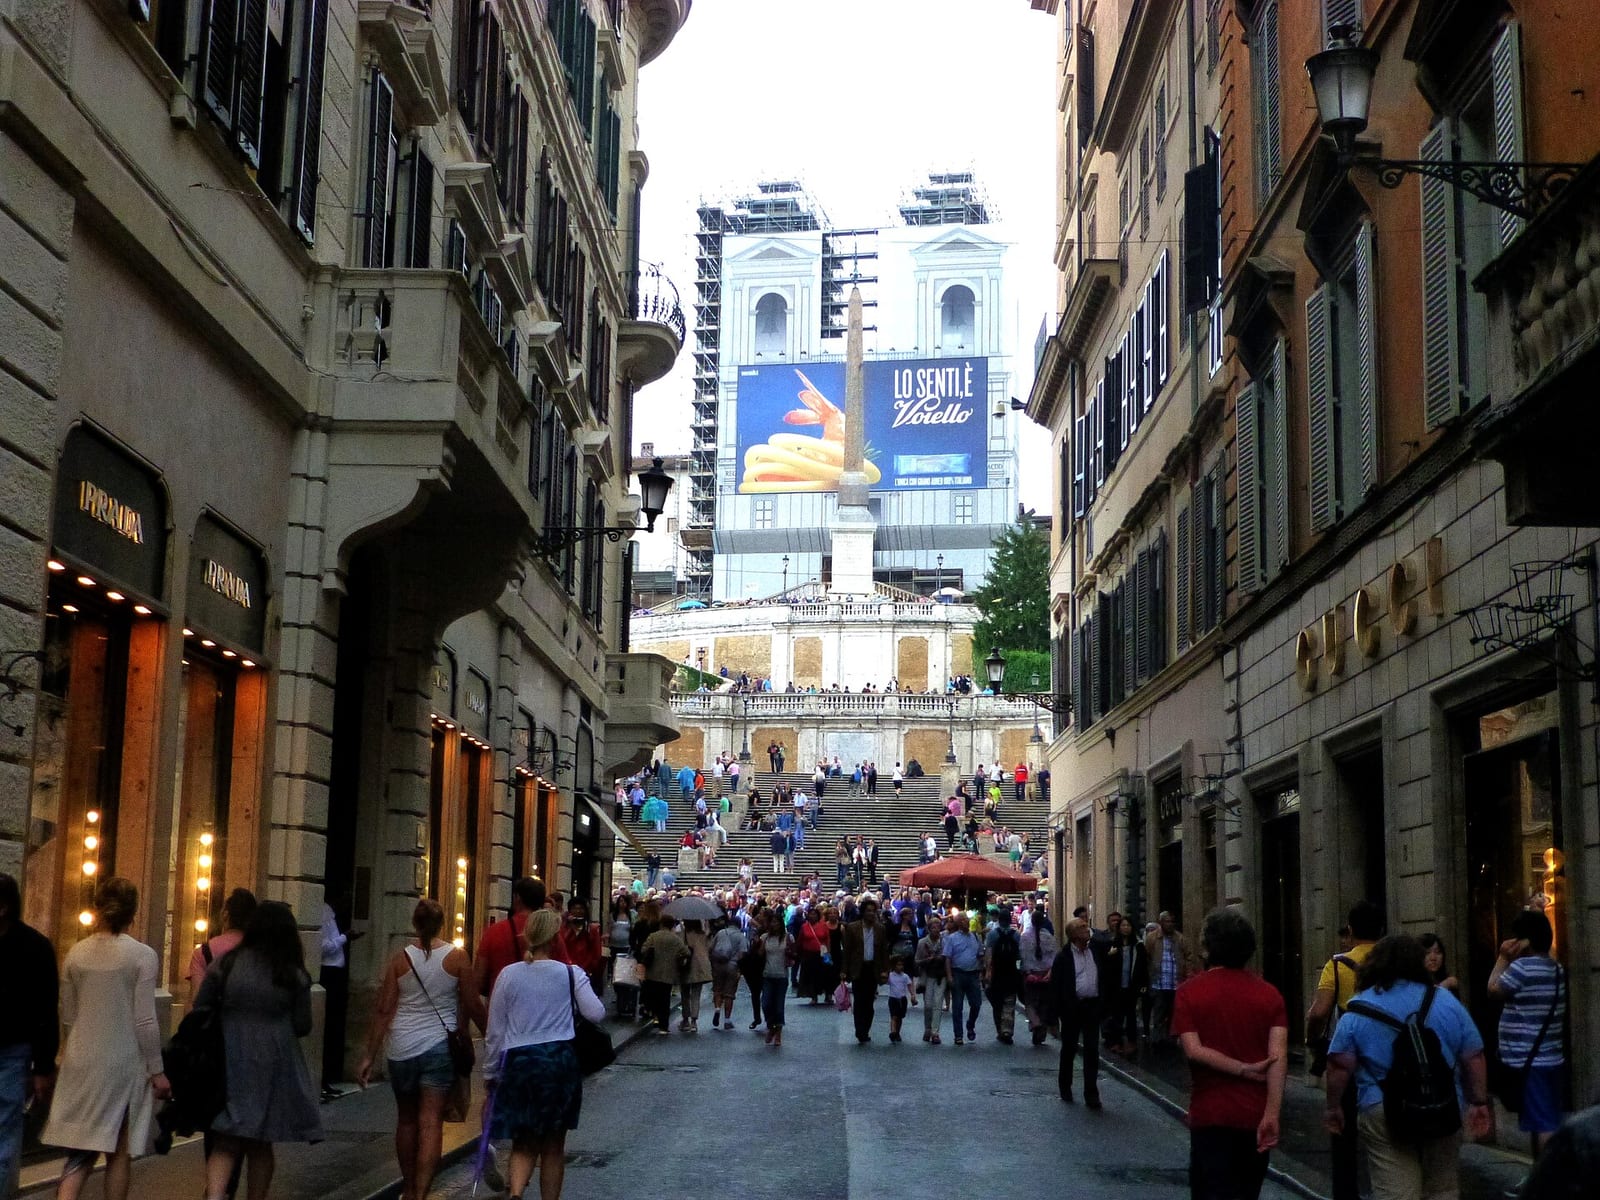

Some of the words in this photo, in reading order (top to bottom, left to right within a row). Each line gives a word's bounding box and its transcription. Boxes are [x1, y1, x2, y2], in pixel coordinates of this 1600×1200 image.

[894, 368, 913, 399] LO
[892, 397, 974, 429] Voiello
[80, 480, 144, 544] PRADA
[204, 559, 251, 608] PRADA
[1296, 537, 1444, 692] GUCCI
